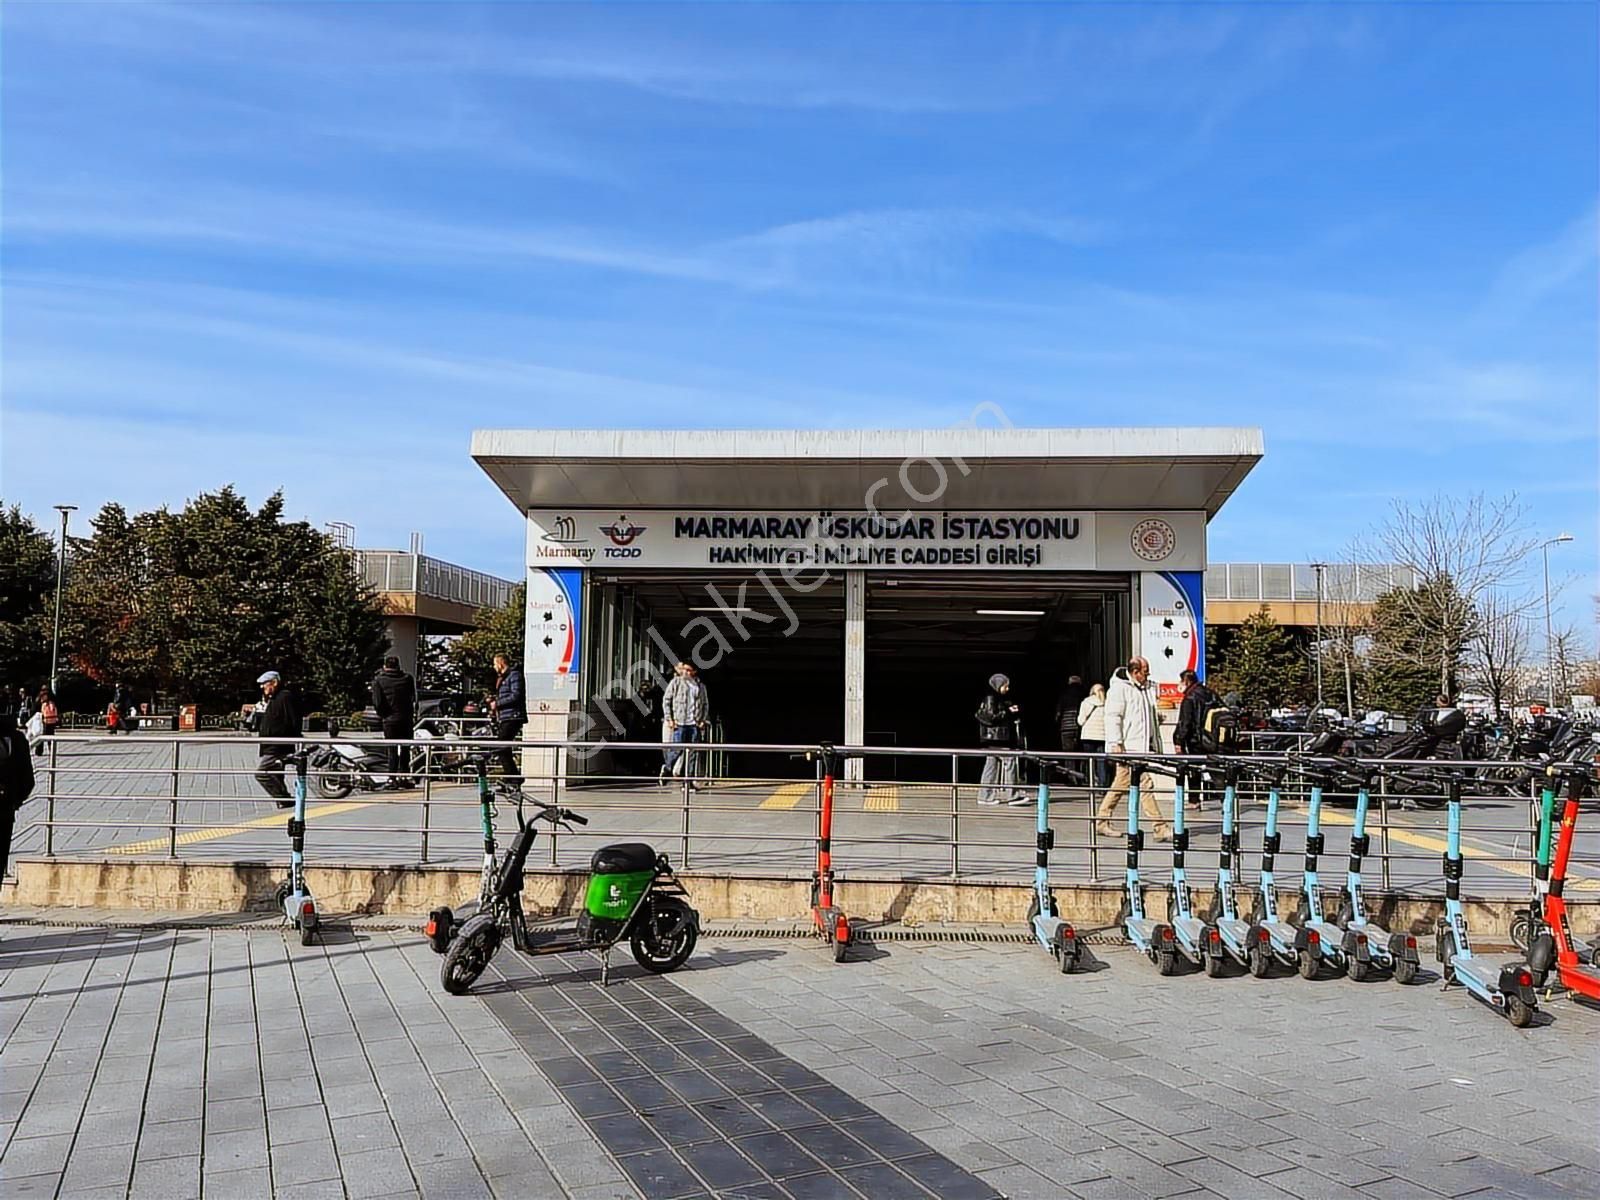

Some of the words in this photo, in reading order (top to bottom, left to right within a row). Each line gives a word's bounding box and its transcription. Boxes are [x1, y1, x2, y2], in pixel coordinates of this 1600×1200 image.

[674, 517, 811, 539] MARMARAY
[818, 511, 935, 539] ÜSKÜDAR
[942, 512, 1080, 539] İSTASYONU
[536, 546, 596, 561] Marmaray
[604, 548, 642, 558] TCDD
[824, 543, 896, 564] MİLLİYE
[901, 544, 981, 565] CADDESİ
[986, 544, 1041, 567] GİRİŞİ
